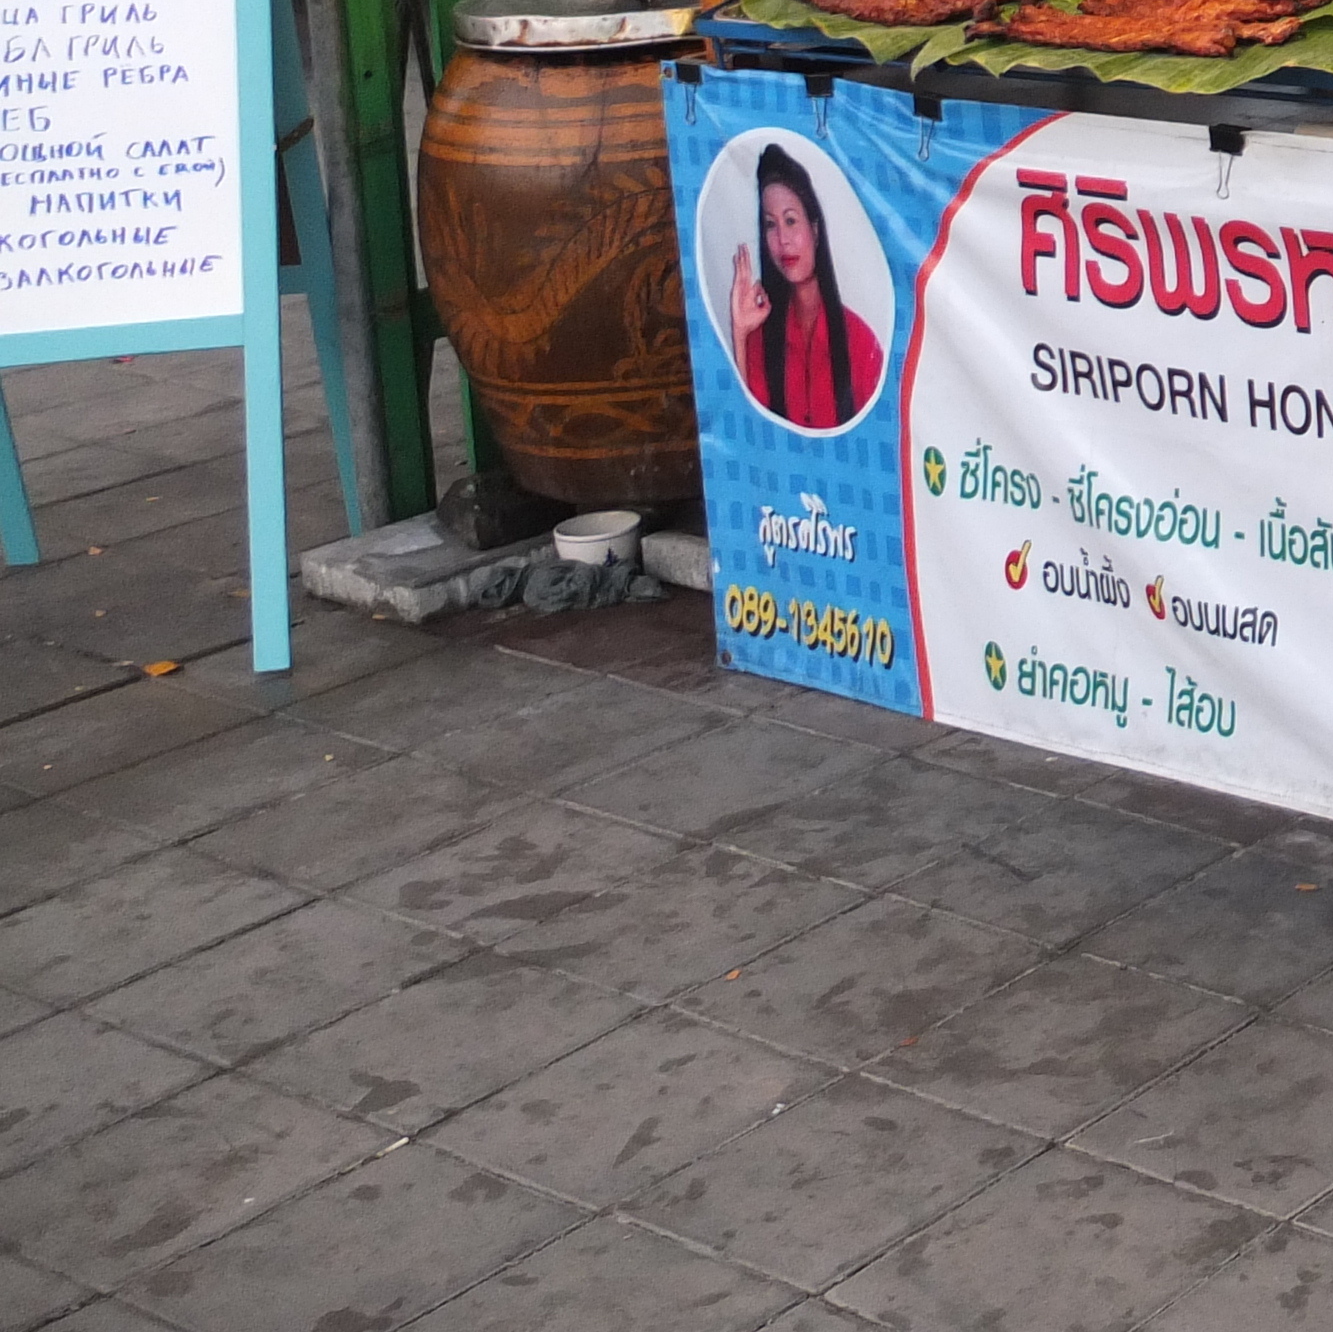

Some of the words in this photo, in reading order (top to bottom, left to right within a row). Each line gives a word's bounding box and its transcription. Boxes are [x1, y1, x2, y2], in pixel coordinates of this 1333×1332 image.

[61, 3, 158, 25] ГРИЛЬ
[68, 34, 165, 61] ГРИЛЬ
[126, 135, 216, 160] САЛАТ
[29, 188, 183, 216] НАПИТКИ
[1031, 343, 1229, 423] SIRIPORN
[960, 438, 1042, 510] ซี่โครง
[1068, 465, 1221, 549] ซี่โครงอ่อน
[724, 583, 895, 669] 089-1345610
[1043, 548, 1131, 609] อบน้ำผึ้ง
[1172, 594, 1278, 647] อบนมสด
[1166, 666, 1237, 738] ไส้อบ
